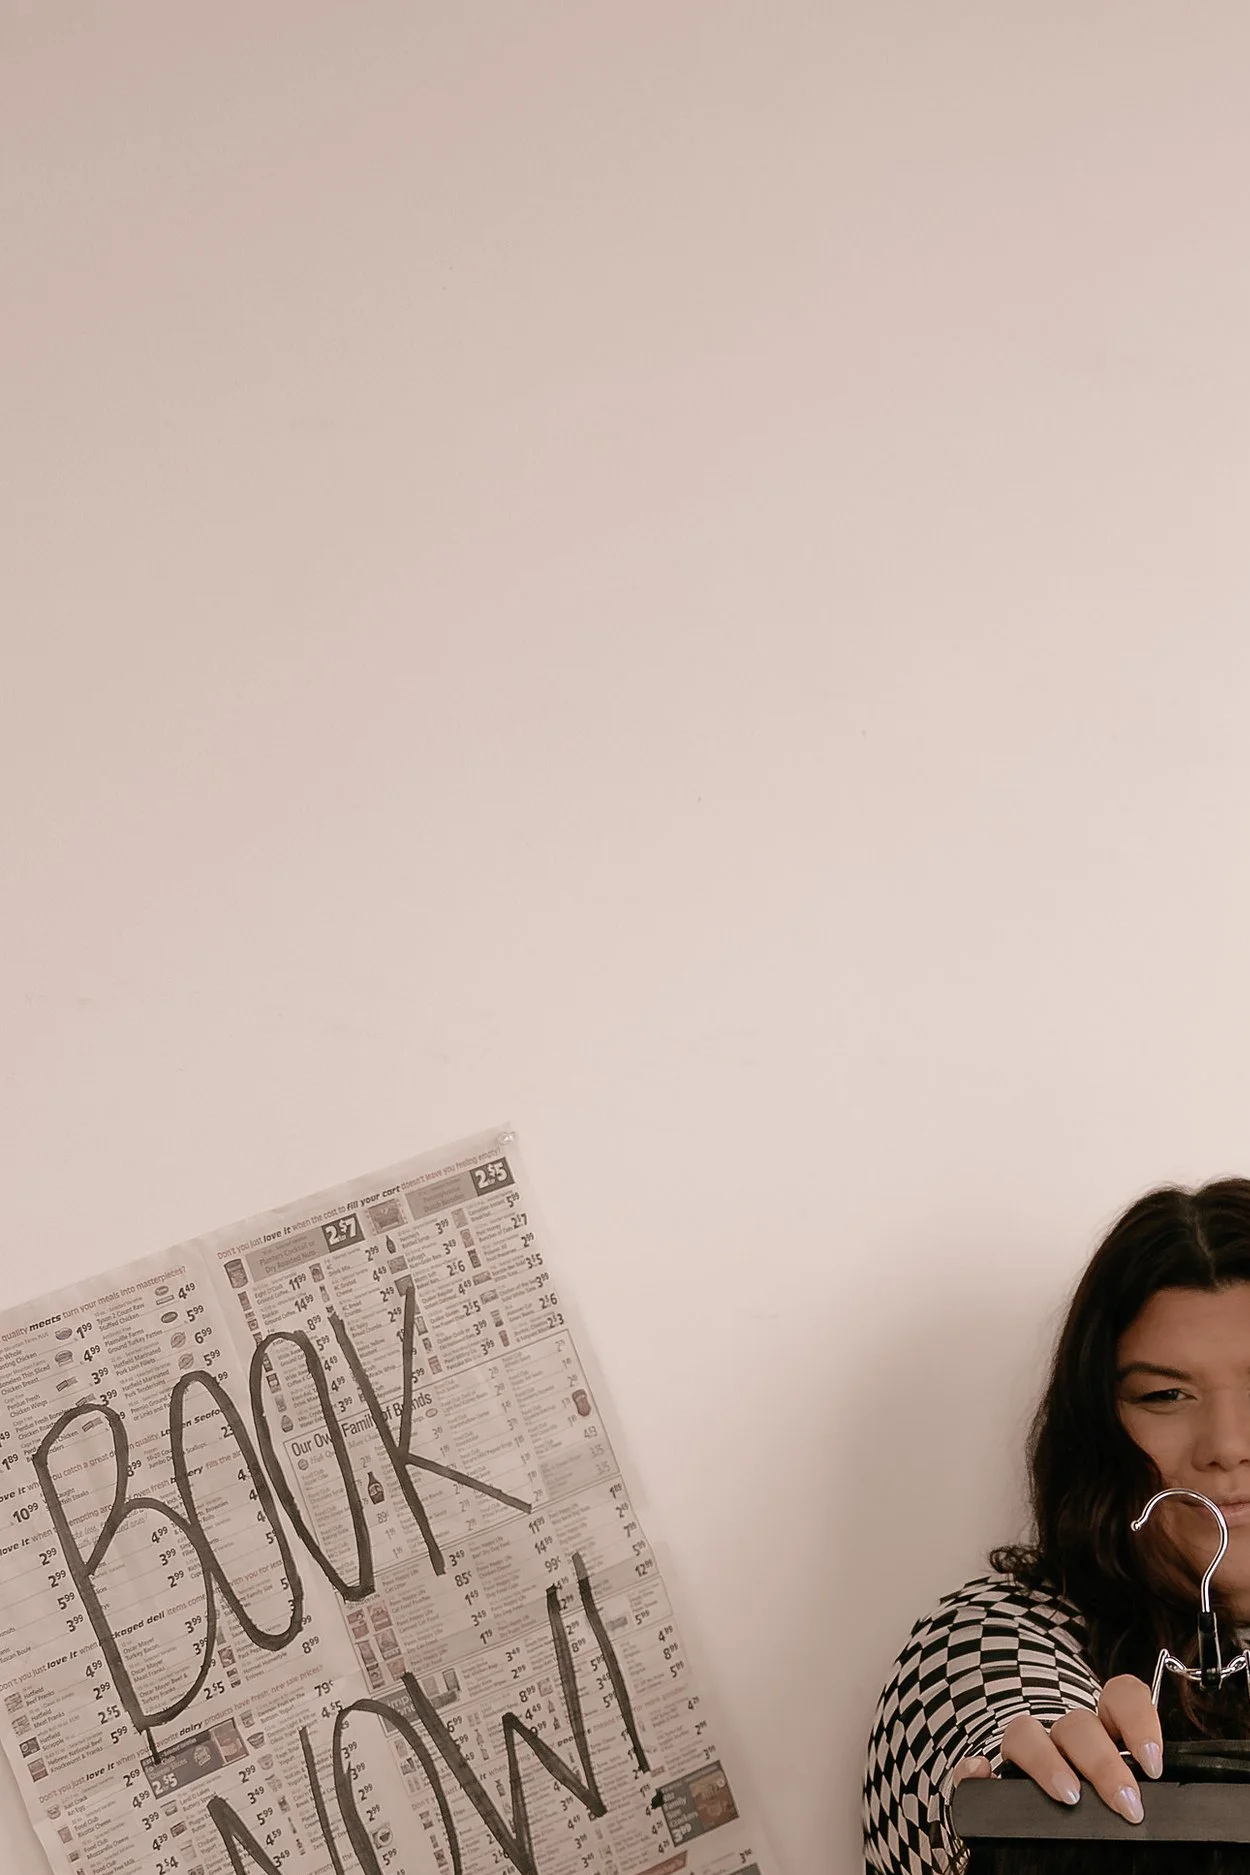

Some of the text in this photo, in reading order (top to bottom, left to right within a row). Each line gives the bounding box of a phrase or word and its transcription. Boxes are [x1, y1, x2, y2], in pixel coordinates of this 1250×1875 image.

[216, 1246, 236, 1260] Don't
[236, 1242, 250, 1254] you
[249, 1236, 263, 1248] just
[262, 1228, 282, 1242] love
[282, 1225, 292, 1235] it
[291, 1218, 310, 1231] when
[310, 1213, 323, 1224] the
[322, 1208, 338, 1220] cost
[337, 1205, 346, 1214] to
[345, 1199, 359, 1211] fill
[359, 1192, 381, 1207] your
[381, 1184, 401, 1198] cart
[400, 1175, 425, 1190] doesn't
[425, 1168, 443, 1181] leave
[442, 1164, 456, 1175] you
[455, 1155, 477, 1170] feeling
[0, 1325, 29, 1344] quality
[28, 1312, 62, 1332] meats
[62, 1306, 80, 1319] turn
[79, 1300, 97, 1314] your
[96, 1290, 120, 1306] meals
[119, 1284, 136, 1297] into
[135, 1265, 187, 1292] masterpieces?
[61, 1462, 83, 1477] catch
[82, 1461, 89, 1469] a
[88, 1452, 110, 1468] great
[149, 1478, 170, 1493] fresh
[205, 1459, 218, 1470] fills
[290, 1436, 313, 1457] Our
[33, 1285, 533, 1764] BOOK
[18, 1671, 33, 1684] you
[32, 1664, 47, 1677] just
[46, 1654, 68, 1670] love
[68, 1649, 79, 1659] it
[145, 1610, 165, 1625] deli
[166, 1601, 187, 1616] items
[244, 1570, 258, 1582] you
[258, 1564, 270, 1574] for
[58, 1783, 73, 1795] you
[84, 1766, 105, 1781] love
[105, 1761, 115, 1771] it
[116, 1752, 136, 1766] when
[178, 1719, 203, 1738] dairy
[233, 1698, 249, 1710] have
[270, 1682, 284, 1693] new
